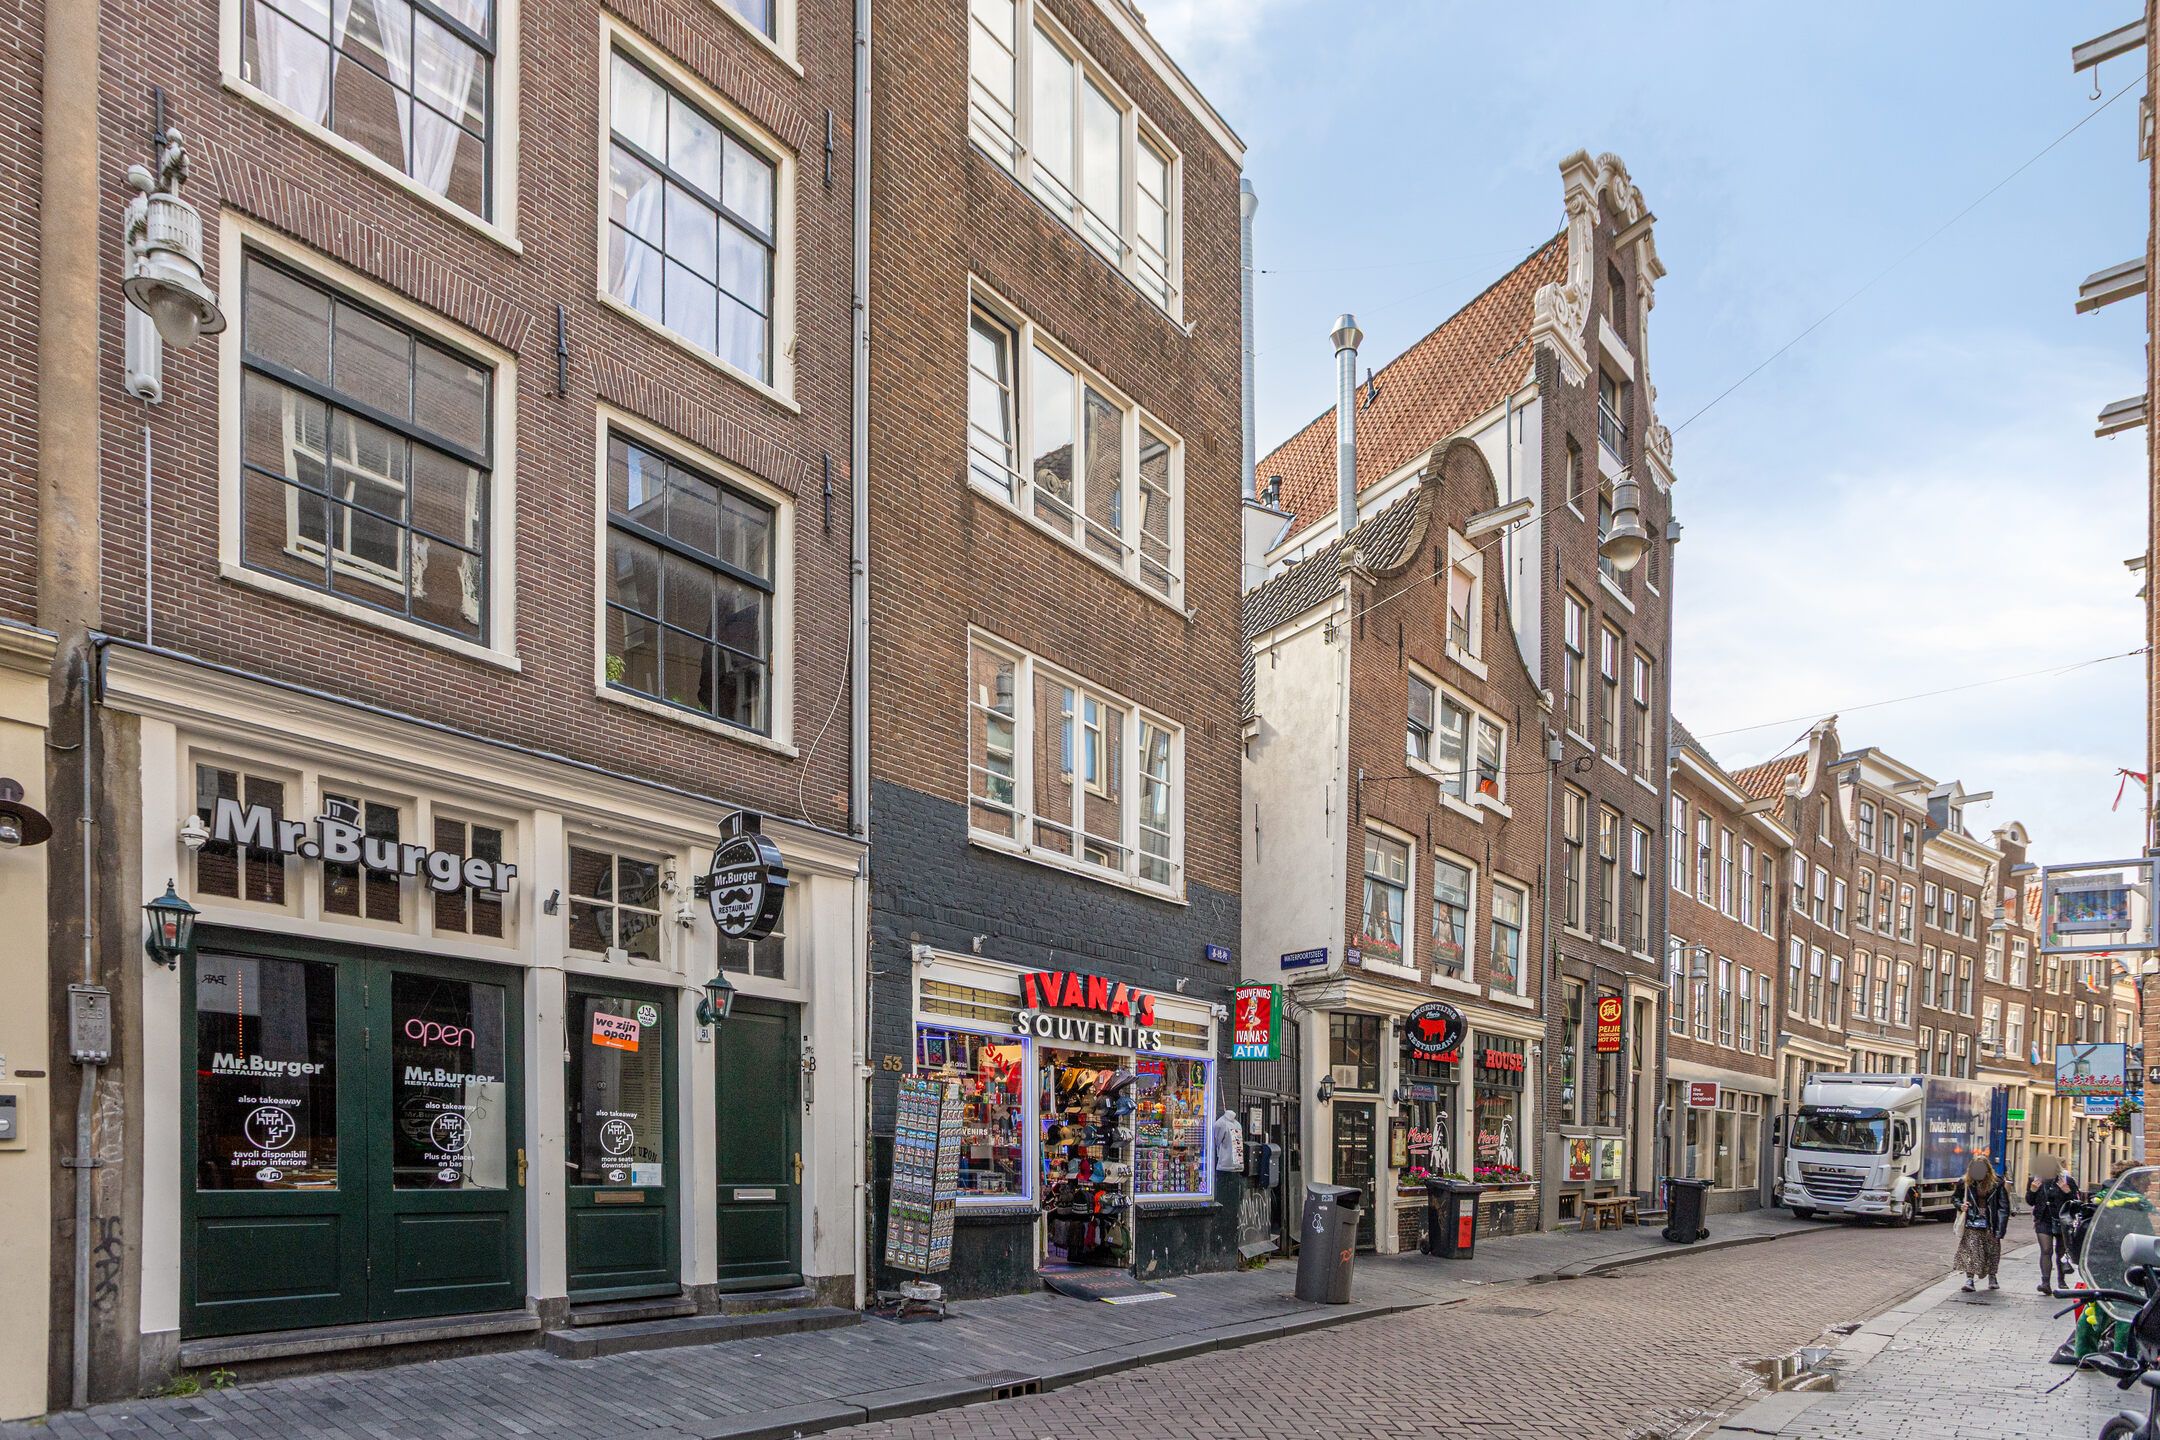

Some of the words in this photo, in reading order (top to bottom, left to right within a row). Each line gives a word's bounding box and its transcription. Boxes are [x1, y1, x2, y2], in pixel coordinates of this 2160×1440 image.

[213, 797, 517, 892] Mr.Burger
[714, 871, 757, 887] Mr.Burger
[718, 902, 754, 915] RESTAURANT
[1020, 971, 1156, 1027] IVANA'S
[1236, 988, 1272, 1000] SOUVENIRS
[596, 1017, 613, 1028] we
[616, 1021, 636, 1033] zijn
[1015, 1011, 1162, 1051] SOUVENIRS
[604, 1030, 632, 1041] open
[1236, 1030, 1268, 1043] IVANA'S
[1407, 1032, 1457, 1052] RESTAURANT
[1235, 1045, 1268, 1057] ATM
[212, 1052, 324, 1077] Mr.Burger
[882, 1055, 903, 1072] 53
[1485, 1049, 1524, 1072] HOUSE
[212, 1068, 283, 1077] RESTAURANT
[405, 1066, 495, 1085] Mr.Burger
[2149, 1068, 2160, 1080] 4
[238, 1095, 257, 1104] also
[259, 1096, 301, 1107] takeaway
[442, 1103, 476, 1111] takeaway
[609, 1111, 637, 1119] takeaway
[233, 1150, 259, 1158] tavoli
[261, 1150, 307, 1160] disponibili
[452, 1154, 475, 1162] places
[231, 1158, 239, 1166] al
[241, 1158, 267, 1168] piano
[269, 1158, 307, 1166] inferiore
[449, 1160, 462, 1168] bas
